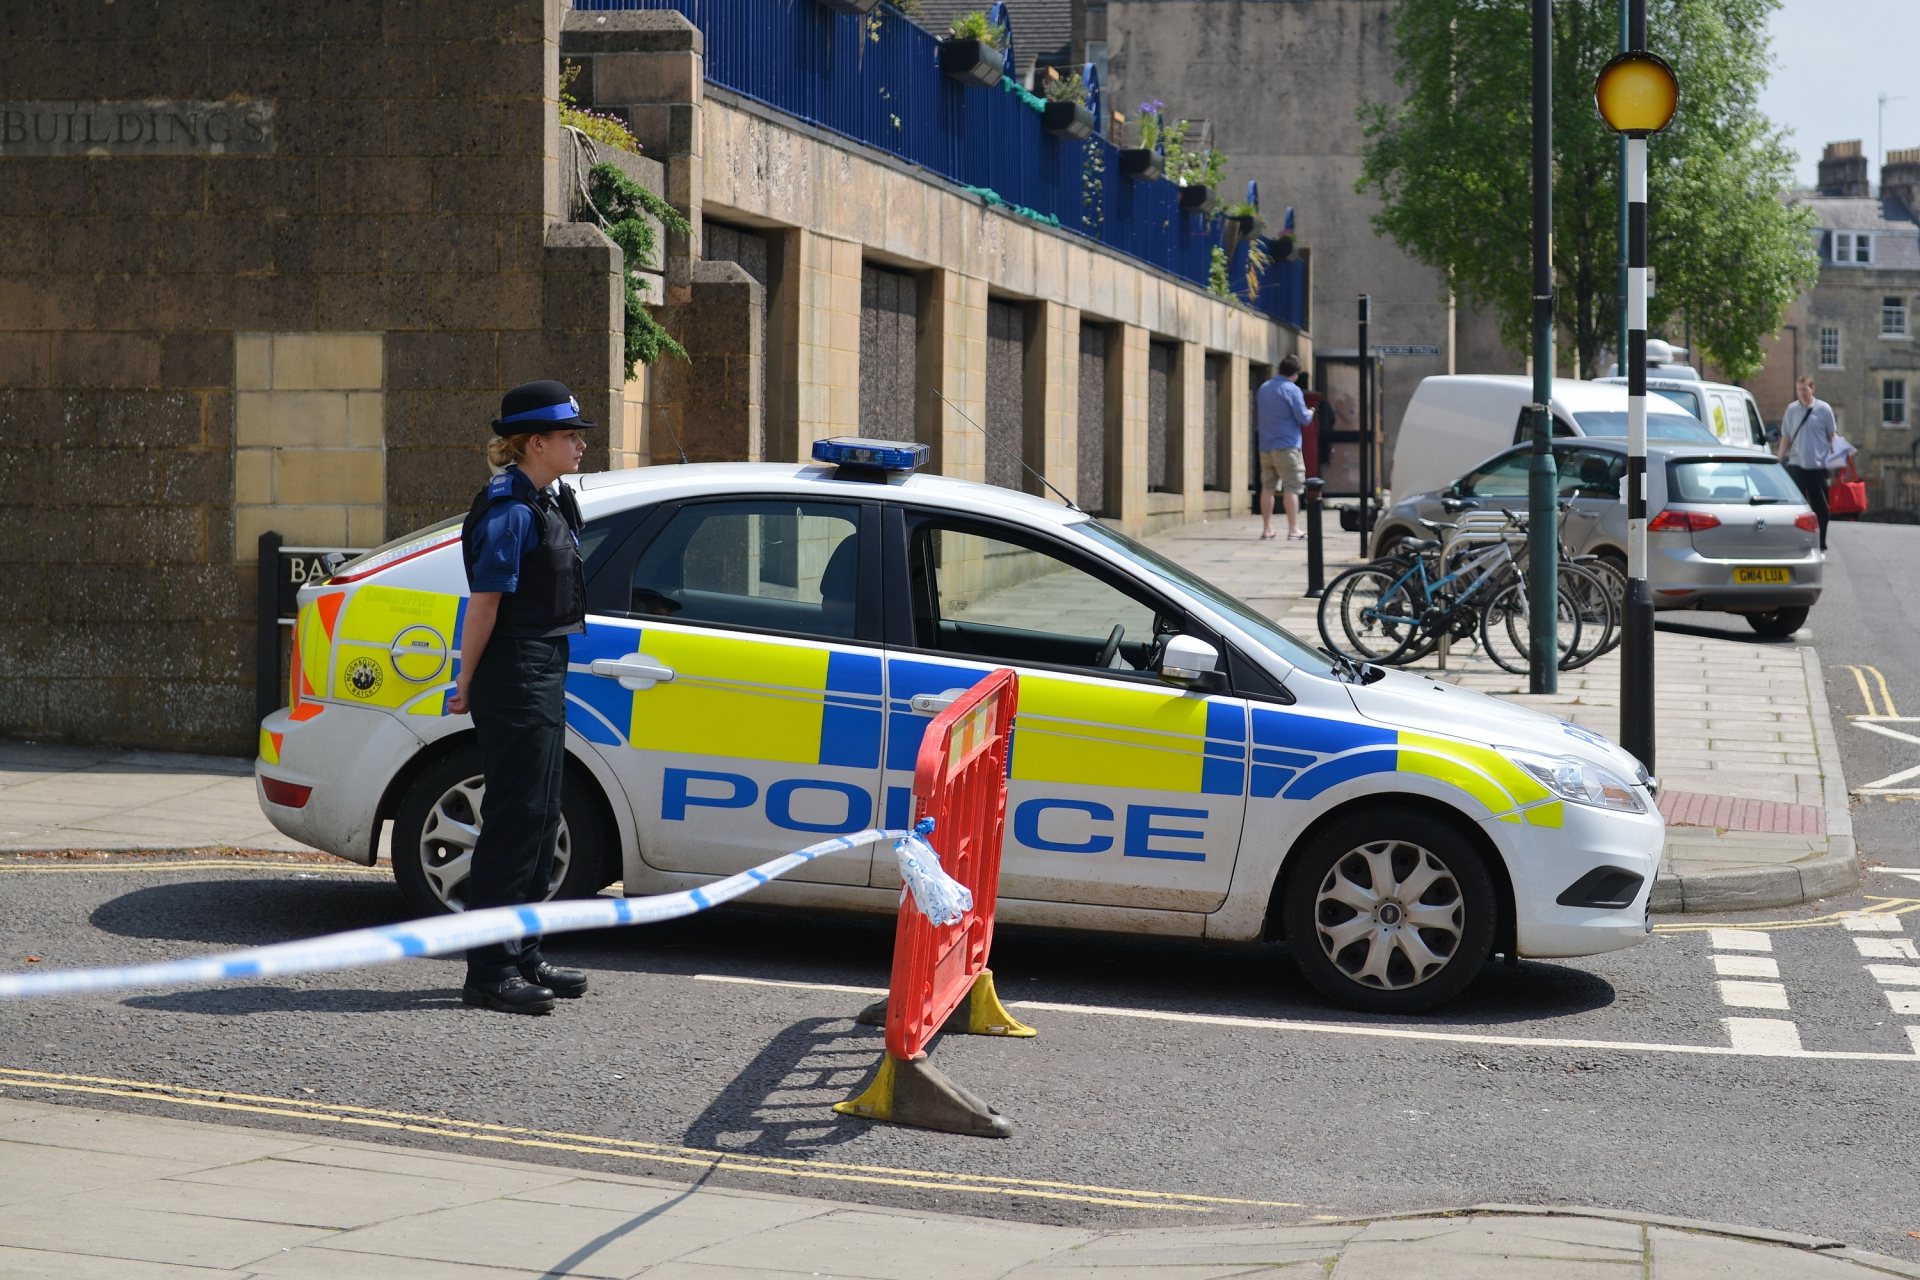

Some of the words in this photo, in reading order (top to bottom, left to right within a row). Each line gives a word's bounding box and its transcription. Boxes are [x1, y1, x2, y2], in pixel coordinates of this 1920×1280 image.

[2, 109, 264, 146] BUILDINGS
[290, 557, 336, 583] BA
[1740, 569, 1762, 582] GM14
[1765, 570, 1784, 582] LUA
[365, 589, 436, 608] CRIMESTOPPERS
[346, 659, 381, 687] NEIGHBOURHOOD
[352, 687, 374, 697] WATCH
[661, 767, 1209, 862] POCE
